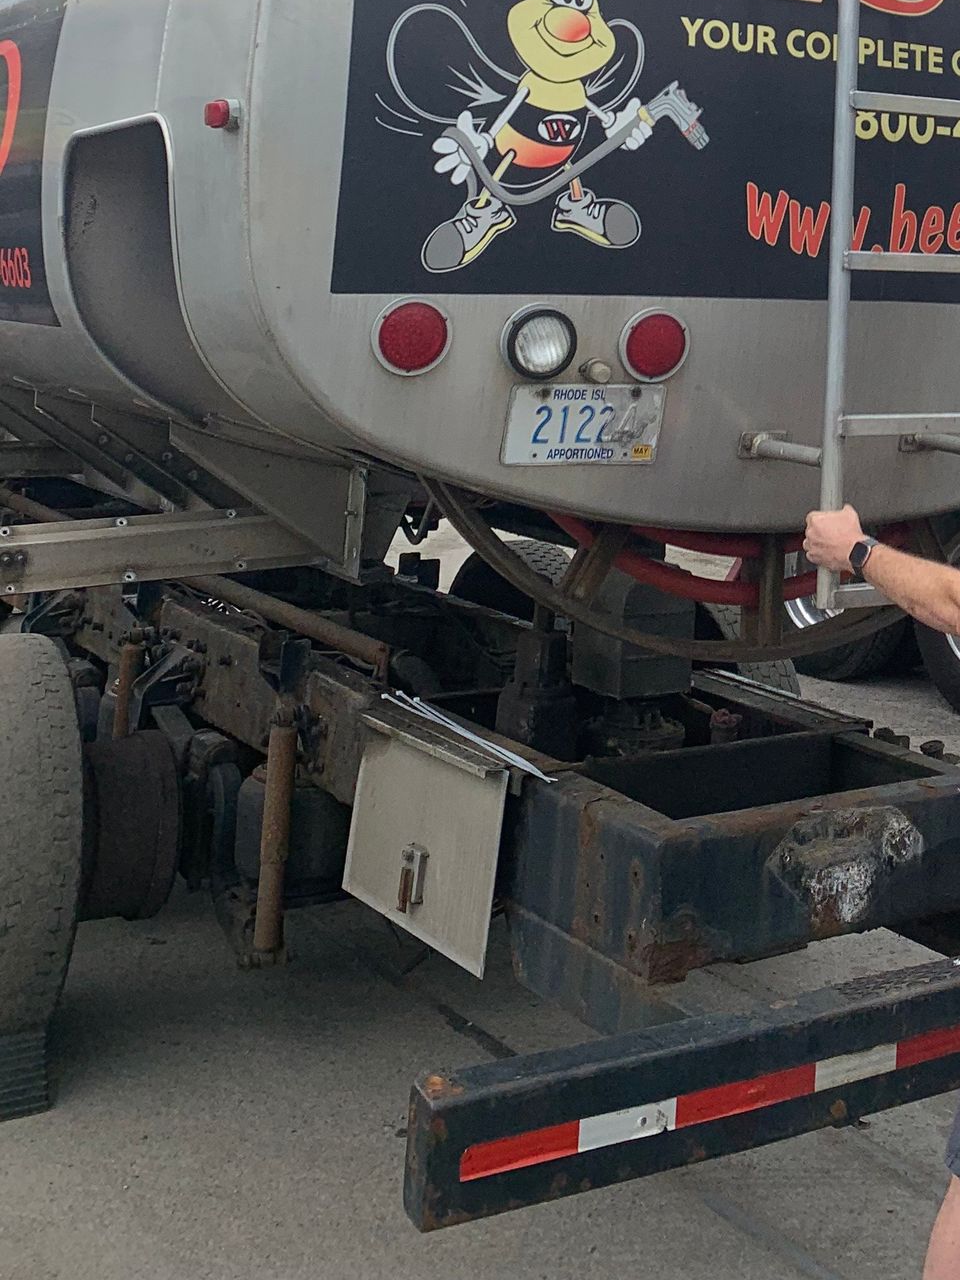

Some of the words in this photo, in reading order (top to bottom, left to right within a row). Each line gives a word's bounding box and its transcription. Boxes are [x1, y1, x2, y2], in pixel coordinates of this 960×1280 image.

[681, 17, 777, 55] YOUR
[553, 389, 587, 400] RHODE
[546, 448, 613, 459] APPORTIONED
[633, 447, 648, 455] MAY
